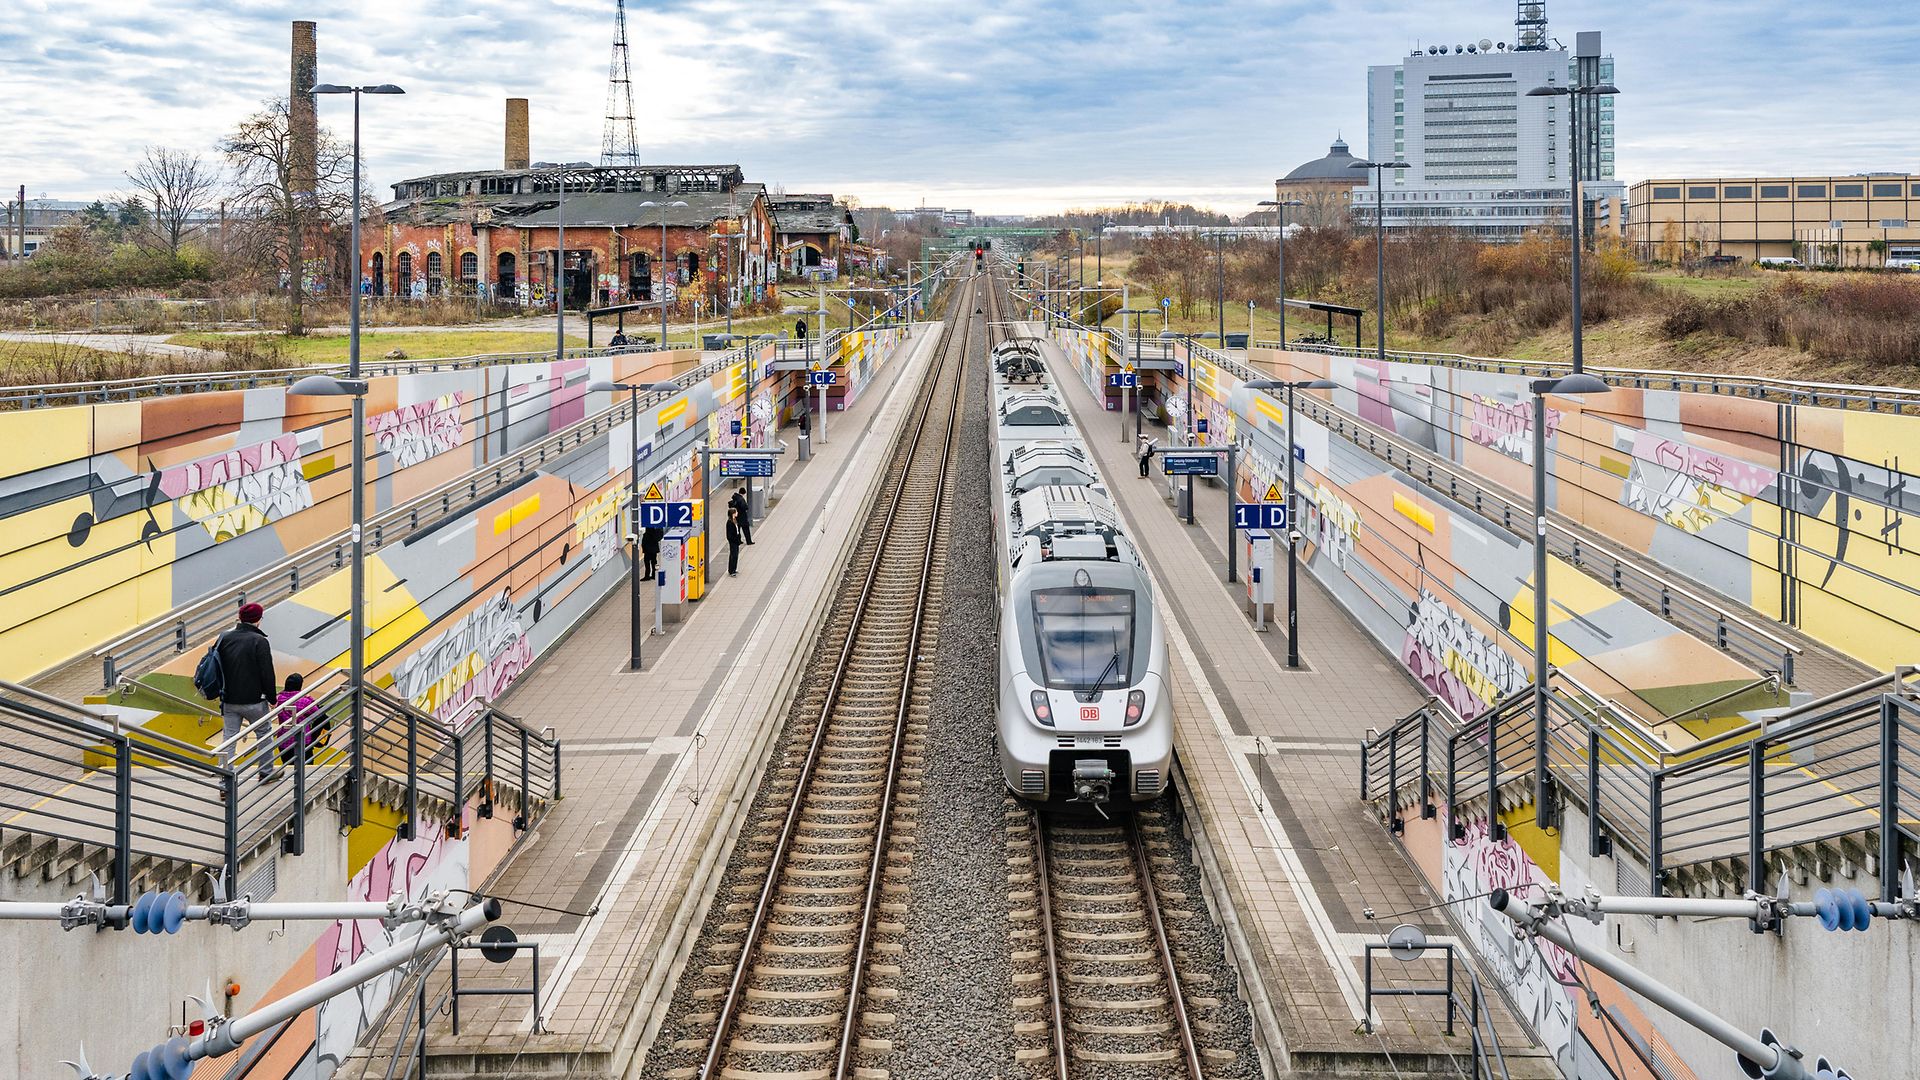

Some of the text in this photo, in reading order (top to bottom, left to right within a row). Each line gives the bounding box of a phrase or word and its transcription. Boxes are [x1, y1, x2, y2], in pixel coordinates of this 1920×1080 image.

[815, 373, 836, 383] C 2
[1111, 374, 1132, 385] 1 C
[649, 505, 691, 525] D 2
[1237, 507, 1285, 526] 1 D
[1082, 709, 1098, 719] DB
